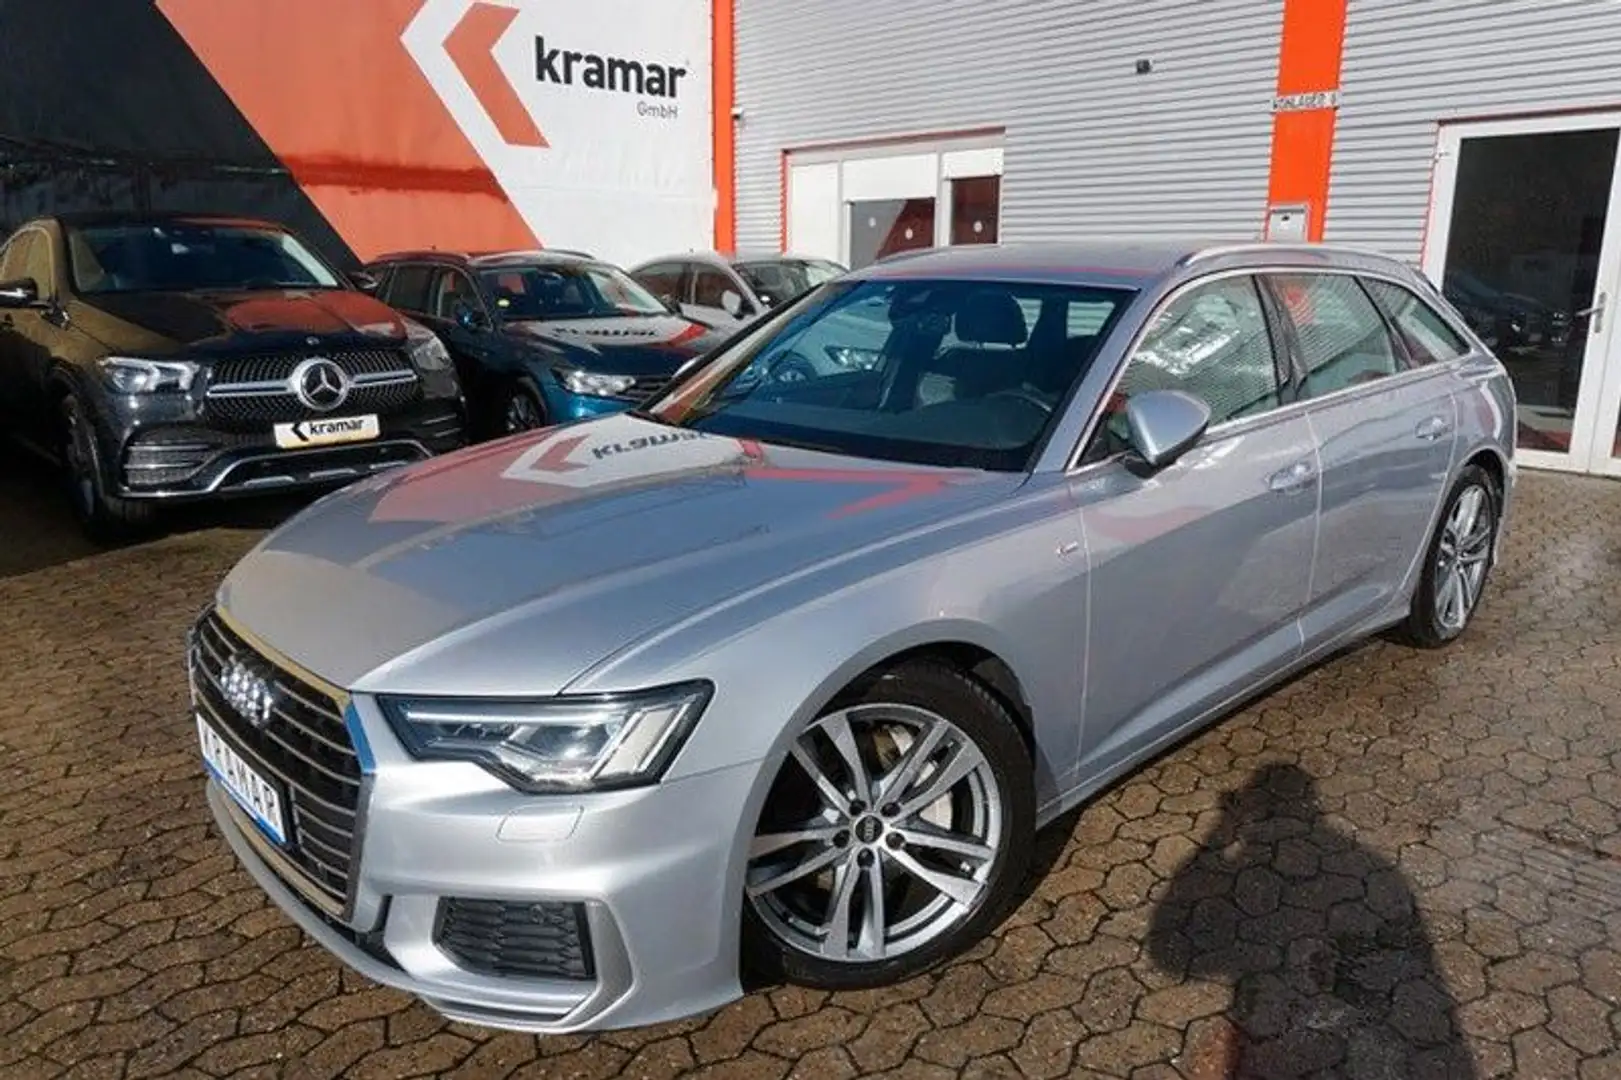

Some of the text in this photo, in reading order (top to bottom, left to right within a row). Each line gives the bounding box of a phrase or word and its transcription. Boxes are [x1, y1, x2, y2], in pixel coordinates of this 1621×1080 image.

[535, 35, 687, 98] kramar
[636, 101, 678, 119] GmbH
[309, 419, 364, 434] kramar
